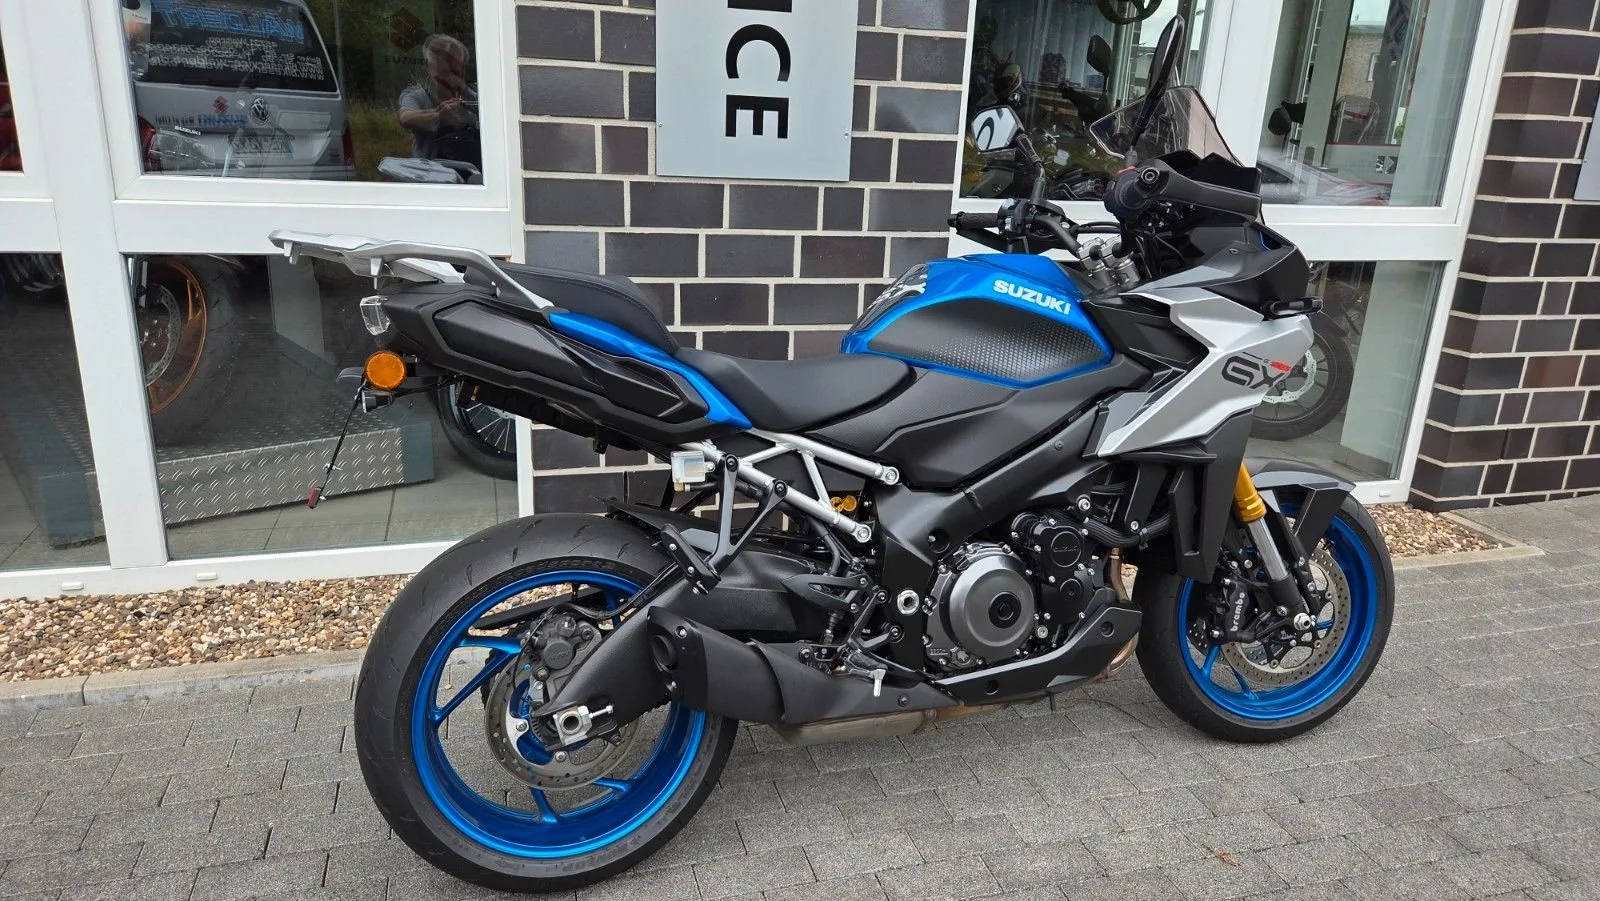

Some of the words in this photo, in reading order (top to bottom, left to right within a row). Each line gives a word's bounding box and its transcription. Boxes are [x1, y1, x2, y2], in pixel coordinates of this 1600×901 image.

[174, 125, 201, 136] SUZUKI
[993, 280, 1071, 315] SUZUKI
[1230, 592, 1246, 632] brembo
